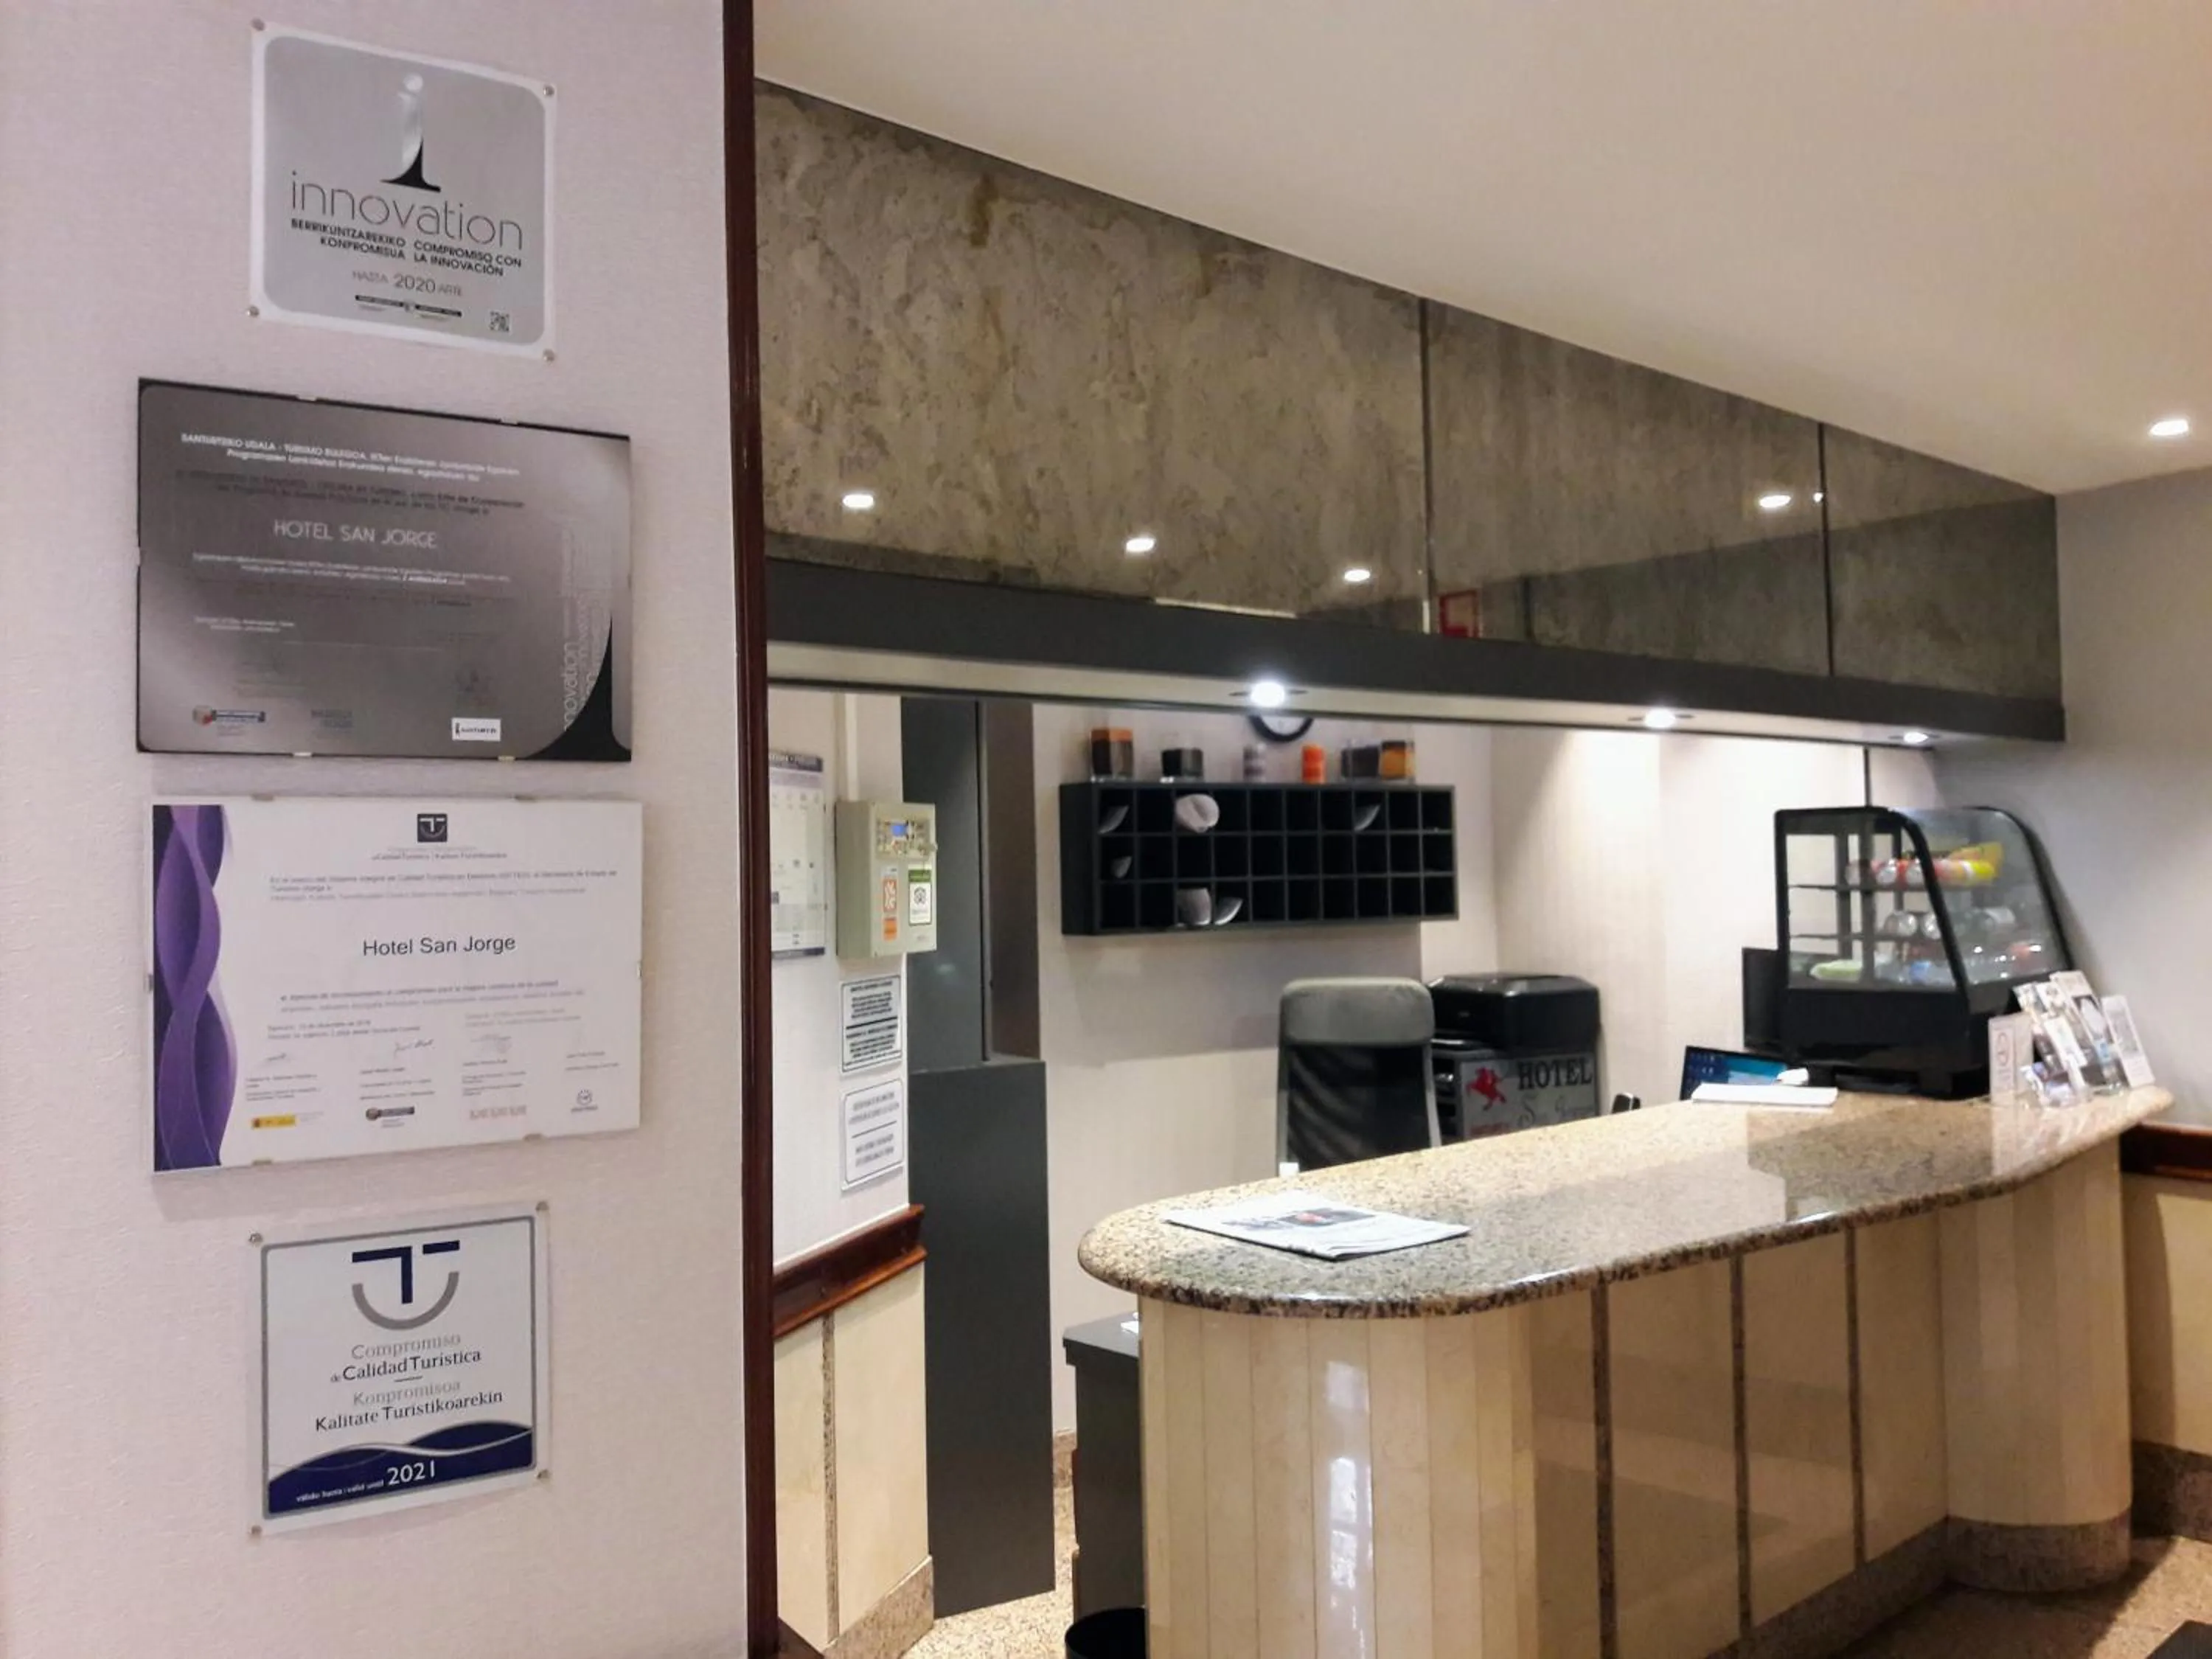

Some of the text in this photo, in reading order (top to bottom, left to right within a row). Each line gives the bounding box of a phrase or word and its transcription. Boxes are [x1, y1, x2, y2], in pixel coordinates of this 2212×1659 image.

[292, 170, 523, 249] innovation
[414, 240, 521, 268] COMPROMISO CON
[414, 252, 428, 262] LA
[394, 273, 436, 293] 2020
[274, 519, 438, 549] HOTEL SAN JORGE
[363, 936, 516, 956] Hotel San Jorge
[1517, 1057, 1593, 1091] HOTEL
[351, 1334, 462, 1360] Compromiso
[315, 1391, 503, 1433] Kalitate Turistikoarekin
[387, 1459, 436, 1485] 2021
